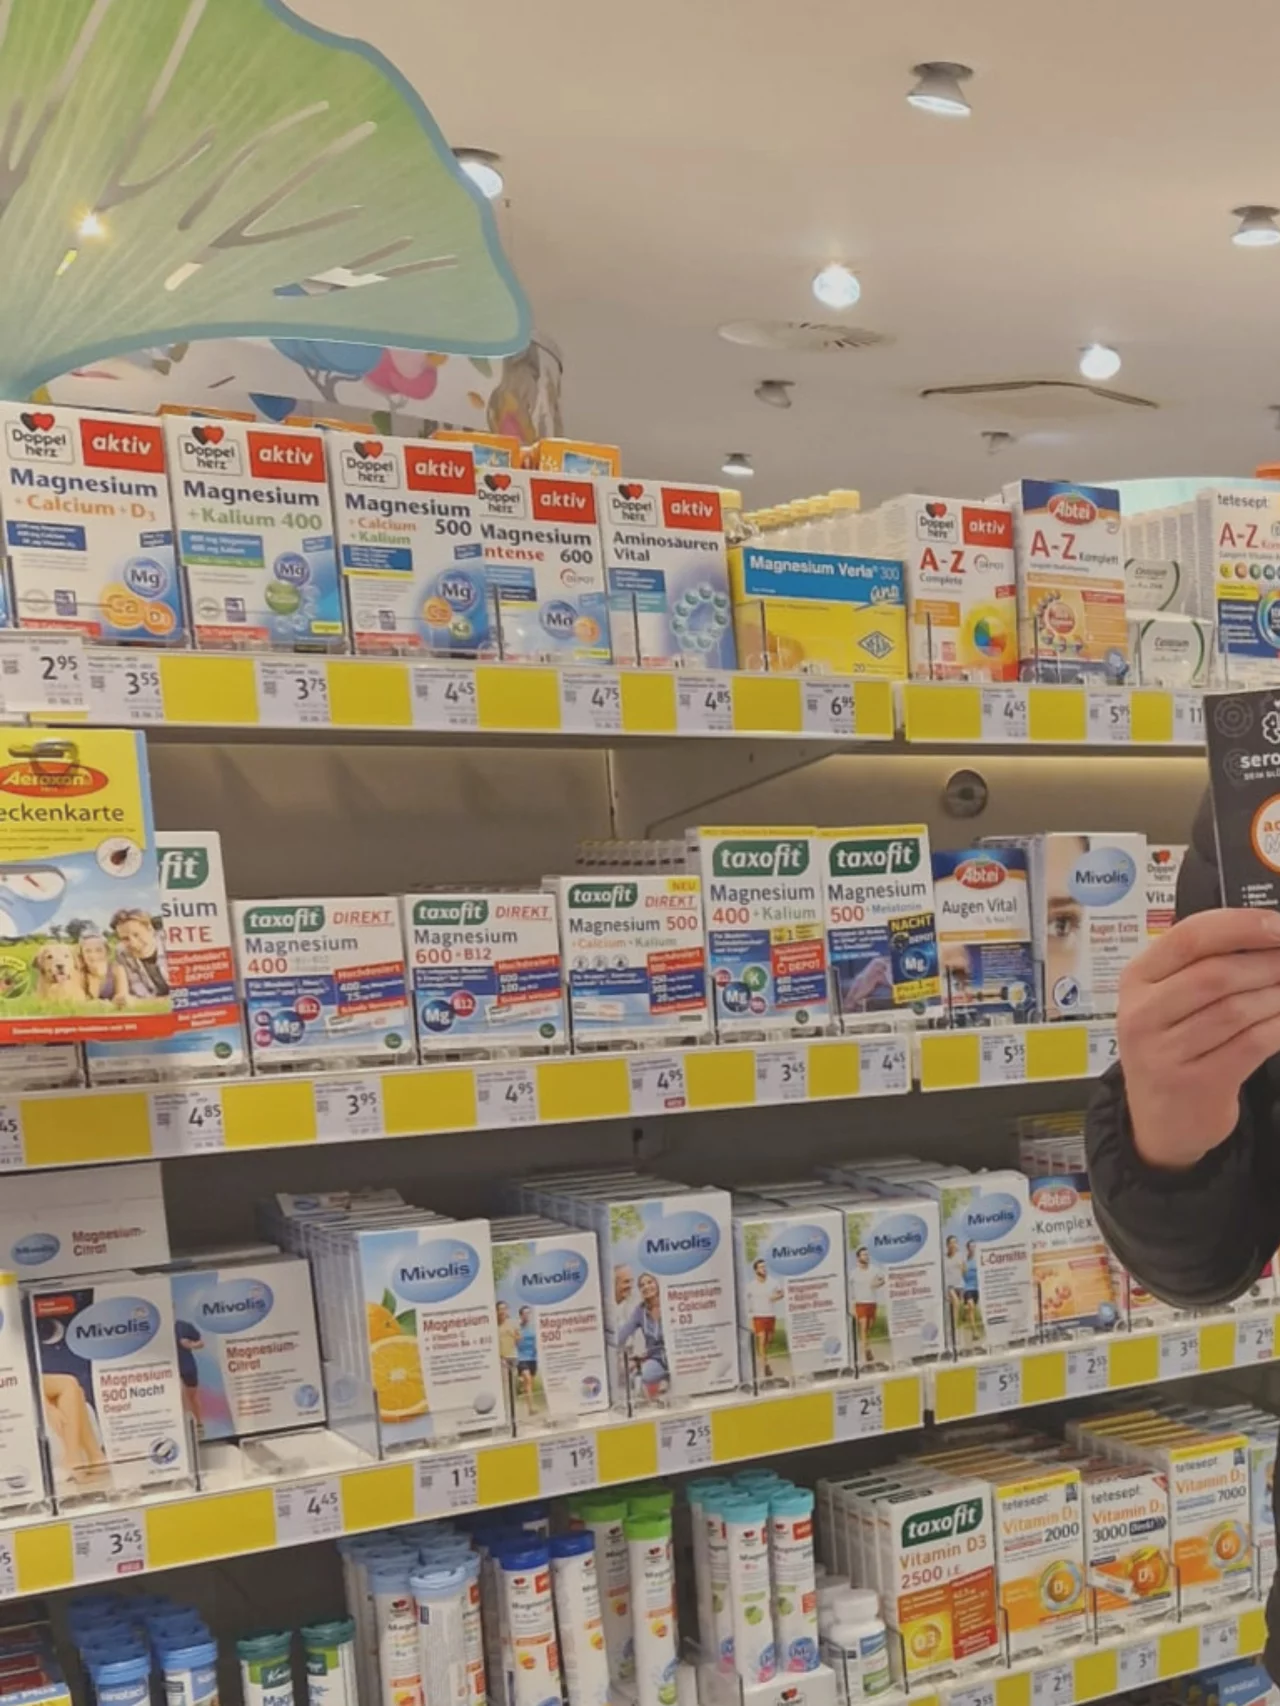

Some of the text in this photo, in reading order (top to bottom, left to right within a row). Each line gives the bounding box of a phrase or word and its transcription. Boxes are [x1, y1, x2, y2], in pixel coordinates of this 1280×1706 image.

[12, 428, 66, 446] Doppel
[92, 433, 152, 456] aktiv
[25, 443, 59, 458] herz
[184, 442, 236, 458] Doppel
[259, 445, 314, 465] aktiv
[196, 457, 227, 471] herz
[346, 457, 393, 473] Doppel
[414, 459, 466, 479] aktiv
[10, 468, 158, 498] Magnesium
[358, 470, 386, 484] herz
[183, 480, 320, 507] Magnesium
[478, 488, 521, 508] Doppel
[539, 491, 587, 510] aktiv
[1217, 494, 1269, 509] tetesept
[27, 494, 115, 517] Calcium
[345, 493, 471, 518] Magnesium
[613, 498, 652, 514] Doppel
[670, 500, 714, 518] aktiv
[1054, 501, 1092, 521] Abtei
[281, 512, 323, 531] 400
[358, 517, 472, 537] Calcium 500
[919, 516, 955, 532] Doppel
[968, 520, 1006, 536] aktiv
[613, 531, 720, 553] Aminosäuren
[1030, 530, 1077, 560] A-Z
[1219, 522, 1260, 549] A-Z
[484, 547, 593, 564] ntense 600
[613, 549, 650, 562] Vital
[920, 547, 966, 574] A-Z
[751, 556, 835, 577] Magnesium
[880, 566, 900, 581] 300
[131, 569, 160, 589] Mg
[442, 583, 471, 601] Mg
[0, 803, 125, 823] eckenkarte
[720, 843, 802, 877] taxofit
[836, 840, 914, 875] taxofit
[960, 865, 999, 884] Abtei
[1075, 869, 1129, 886] Mivolis
[572, 884, 632, 908] taxofit
[644, 895, 696, 908] DIREKT
[710, 884, 815, 907] Magnesium
[827, 881, 927, 904] Magnesium
[1146, 891, 1175, 904] Vita
[419, 901, 549, 925] taxofit DIREKT
[712, 905, 816, 924] 400 Kalium
[830, 905, 865, 924] 500
[942, 897, 1018, 917] Augen Vital
[250, 907, 392, 933] taxofit DIREKT
[569, 915, 698, 936] Magnesium 500
[890, 914, 933, 933] NACHT
[245, 937, 358, 956] Magnesium
[414, 928, 518, 947] Magnesium
[247, 957, 288, 973] 400
[416, 948, 492, 964] 600 B12
[425, 1008, 450, 1024] Mg
[274, 1019, 300, 1036] Mg
[967, 1210, 1015, 1226] Mivolis
[1032, 1216, 1094, 1236] -Komplex
[647, 1236, 712, 1255] Mivolis
[874, 1232, 922, 1248] Mivolis
[772, 1245, 824, 1259] Mivolis
[400, 1263, 471, 1282] Mivolis
[522, 1270, 581, 1286] Mivolis
[202, 1297, 266, 1317] Mivolis
[76, 1317, 151, 1340] Mivolis
[423, 1314, 490, 1334] Magnesium
[540, 1312, 597, 1330] Magnesium
[100, 1368, 173, 1389] Magnesium
[102, 1383, 165, 1402] 500 Nacht
[1175, 1473, 1230, 1496] Vitamin
[1217, 1485, 1247, 1501] 7000
[907, 1503, 978, 1539] taxofit
[1003, 1510, 1060, 1535] Vitamin
[1092, 1503, 1148, 1526] Vitamin
[1044, 1522, 1080, 1544] 2000
[1092, 1523, 1128, 1544] 3000
[900, 1534, 988, 1571] Vitamin D3
[901, 1565, 944, 1590] 2500
